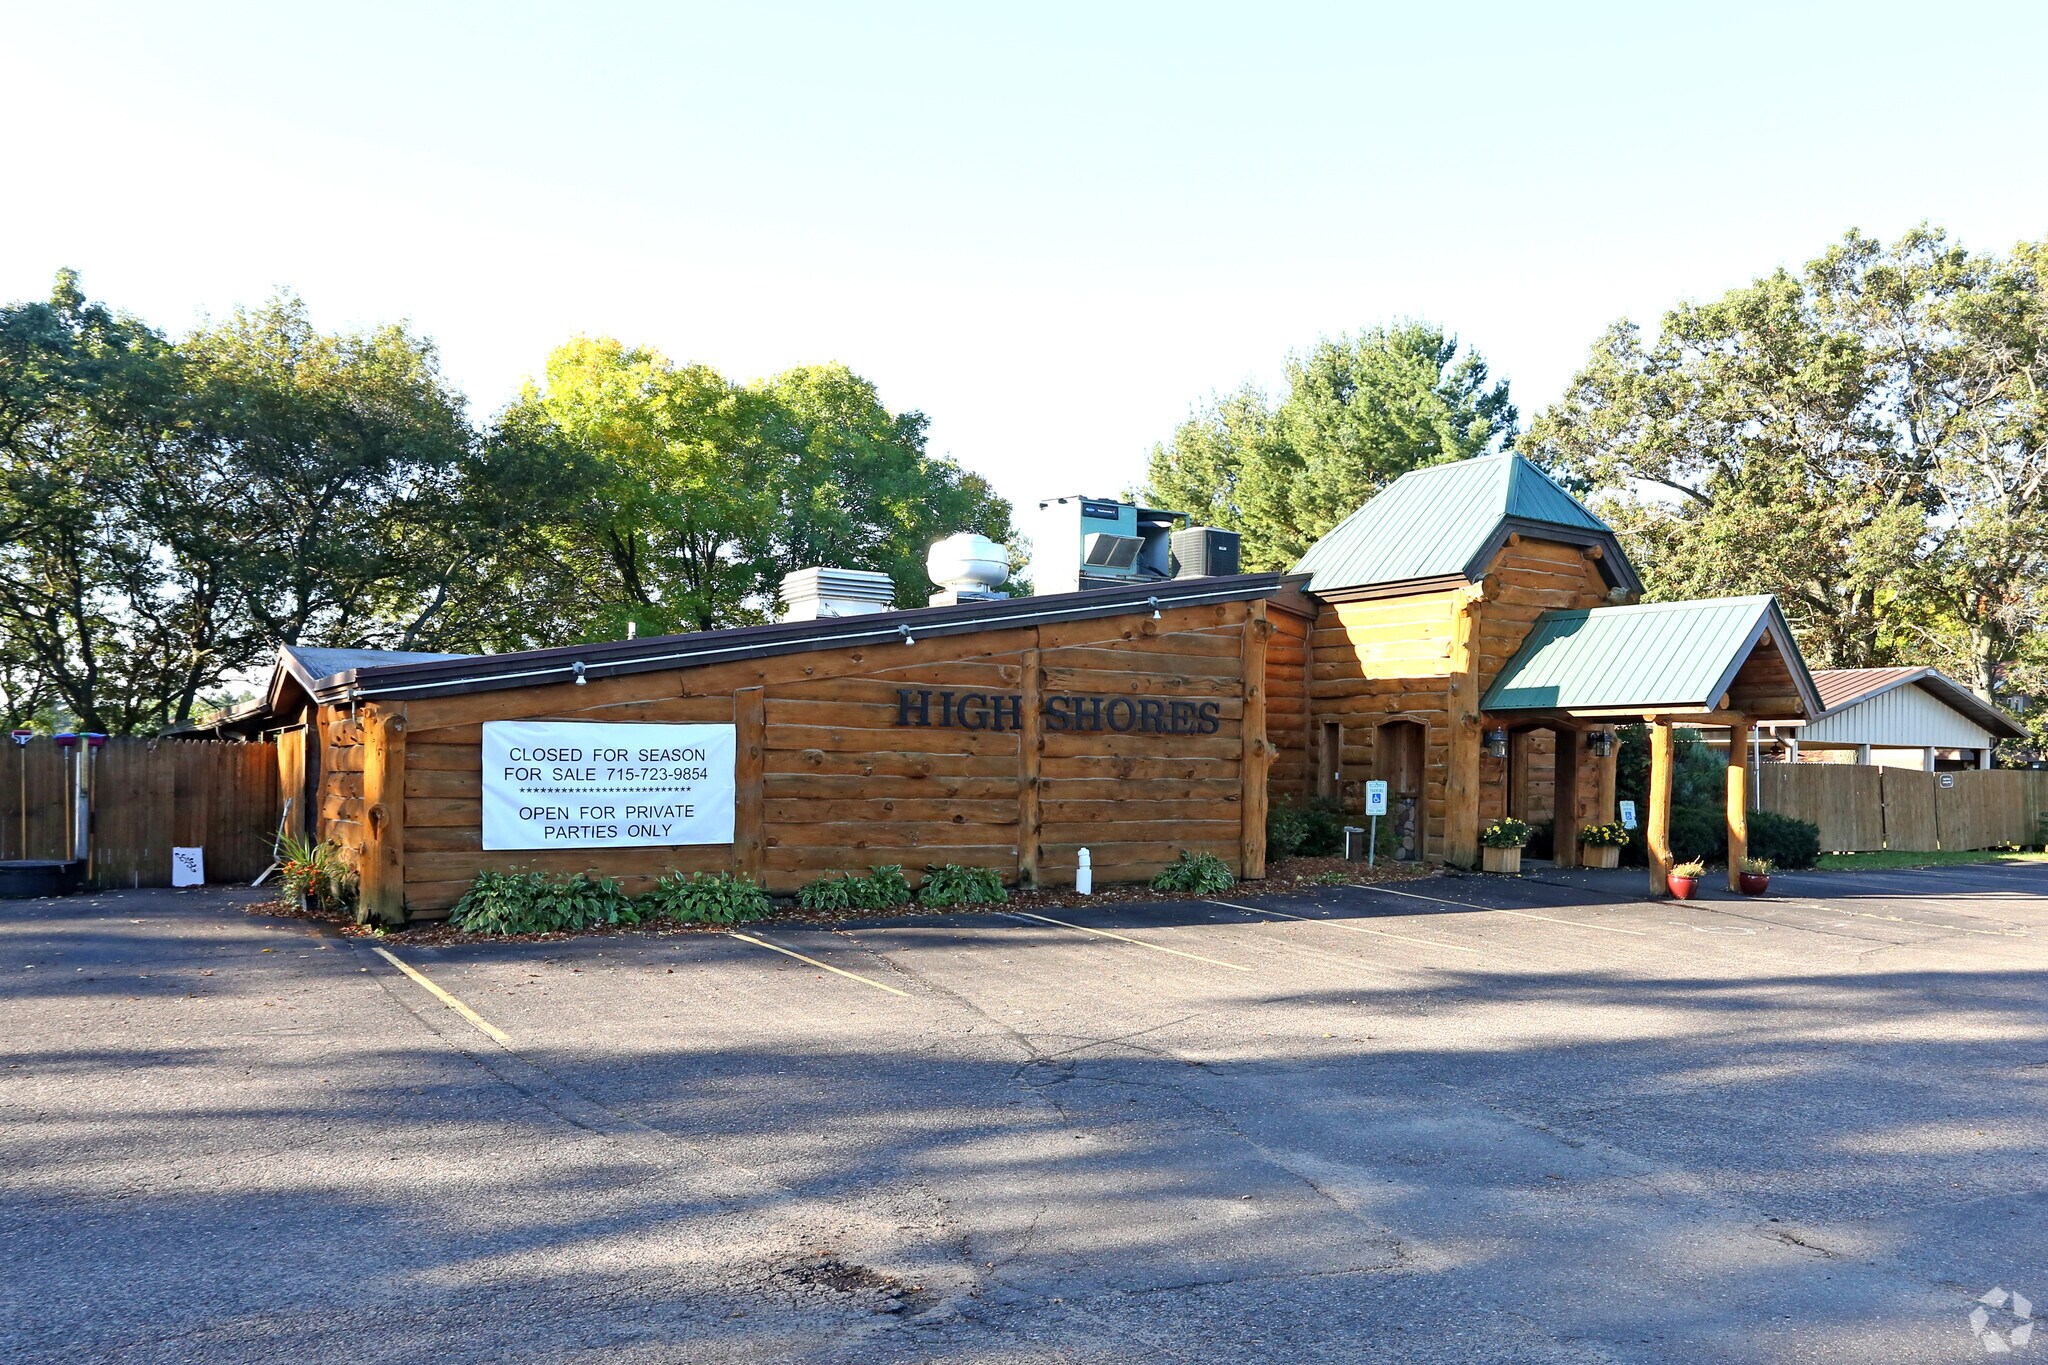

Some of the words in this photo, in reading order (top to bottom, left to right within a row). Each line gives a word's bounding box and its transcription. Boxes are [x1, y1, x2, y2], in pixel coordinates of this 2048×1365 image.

[895, 689, 1023, 731] HIGH
[1046, 695, 1220, 735] SHORES
[509, 747, 583, 762] CLOSED
[593, 748, 629, 762] FOR
[638, 748, 705, 762] SEASON
[504, 767, 542, 781] FOR
[552, 767, 596, 781] SALE
[606, 767, 708, 781] 715-723-9854
[519, 806, 569, 820] OPEN
[579, 806, 616, 820] FOR
[625, 804, 695, 819] PRIVATE
[544, 825, 618, 839] PARTIES
[627, 823, 673, 838] ONLY
